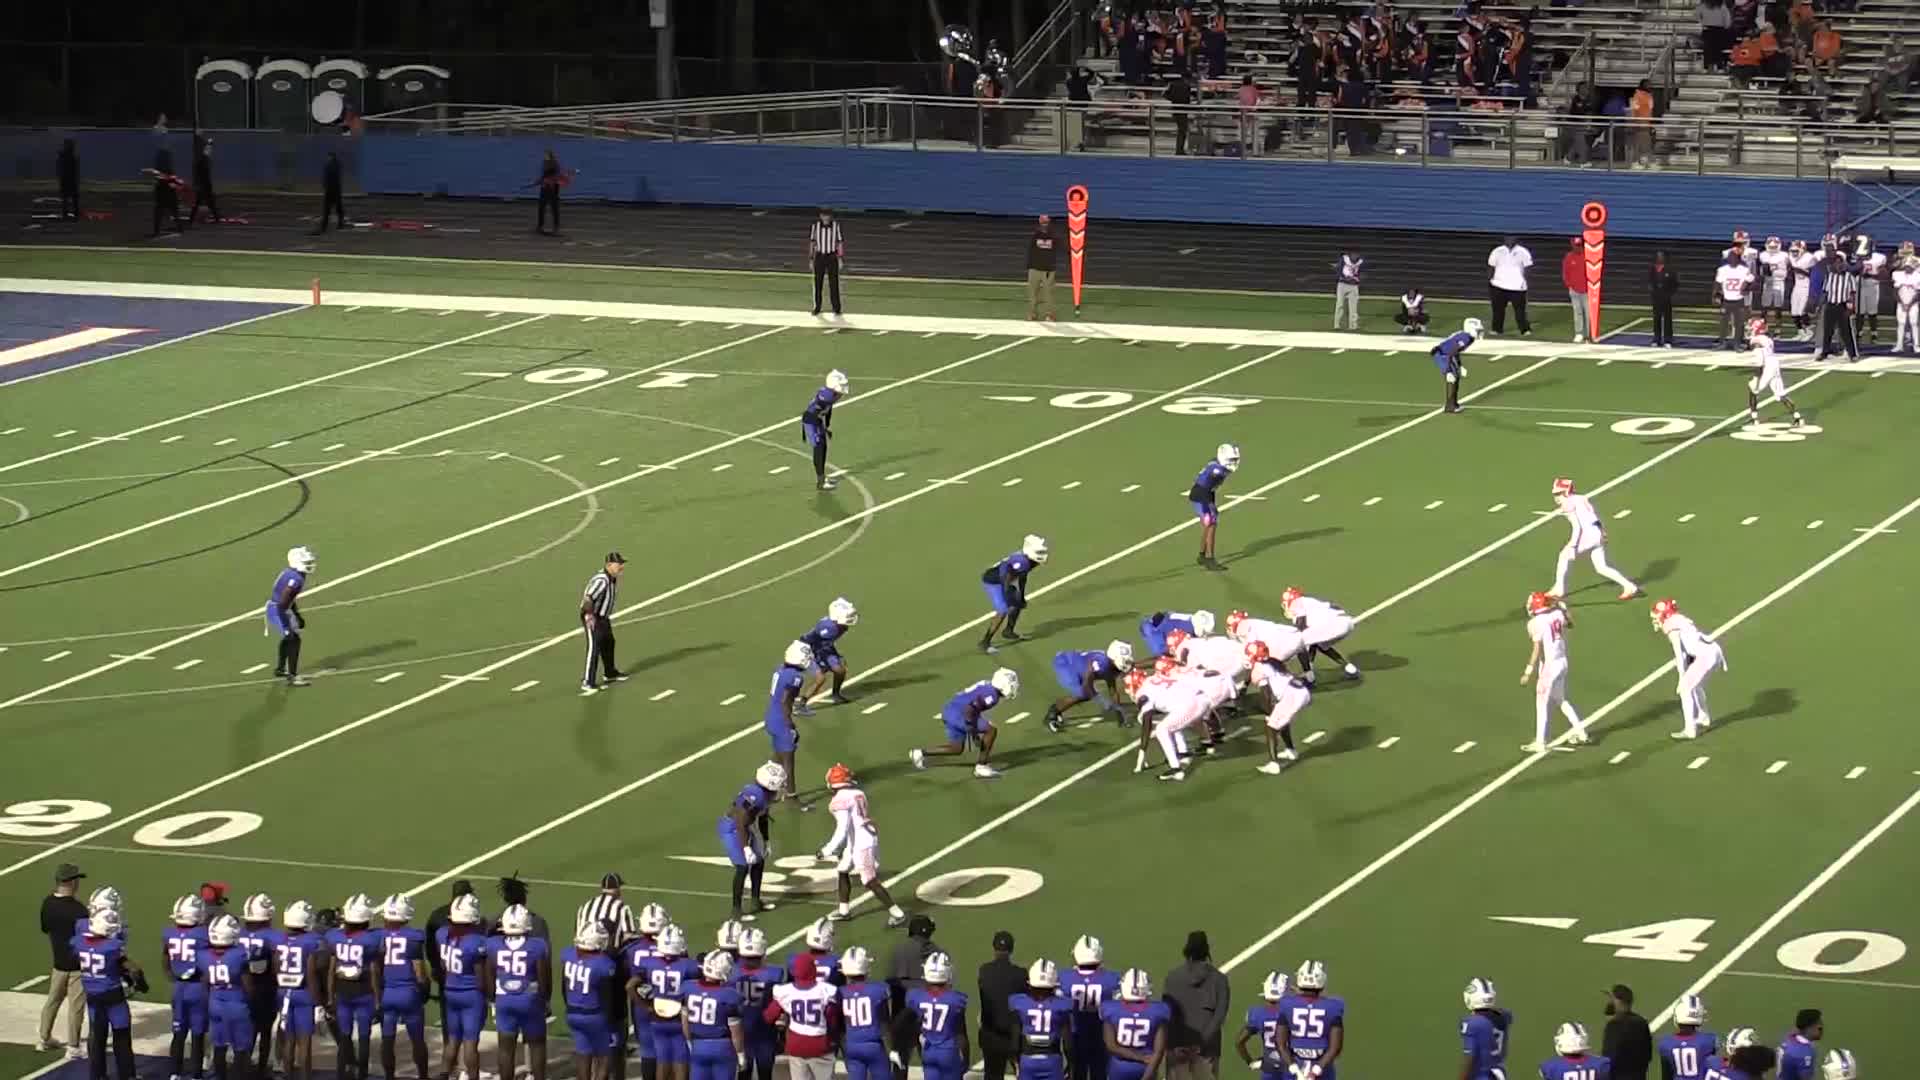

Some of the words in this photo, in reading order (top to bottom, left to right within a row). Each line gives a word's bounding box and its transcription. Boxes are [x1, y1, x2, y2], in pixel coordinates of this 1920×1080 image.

[1857, 235, 1868, 255] 2
[384, 937, 407, 965] 12
[440, 944, 463, 974] 46
[1582, 918, 1907, 974] 40
[497, 950, 527, 976] 56
[564, 961, 591, 994] 44
[651, 970, 681, 995] 93
[687, 995, 717, 1025] 58
[791, 1000, 821, 1026] 85
[843, 997, 872, 1027] 40
[919, 1002, 949, 1032] 37
[1292, 1007, 1325, 1038] 55
[1117, 1018, 1150, 1047] 62
[1672, 1047, 1698, 1076] 10
